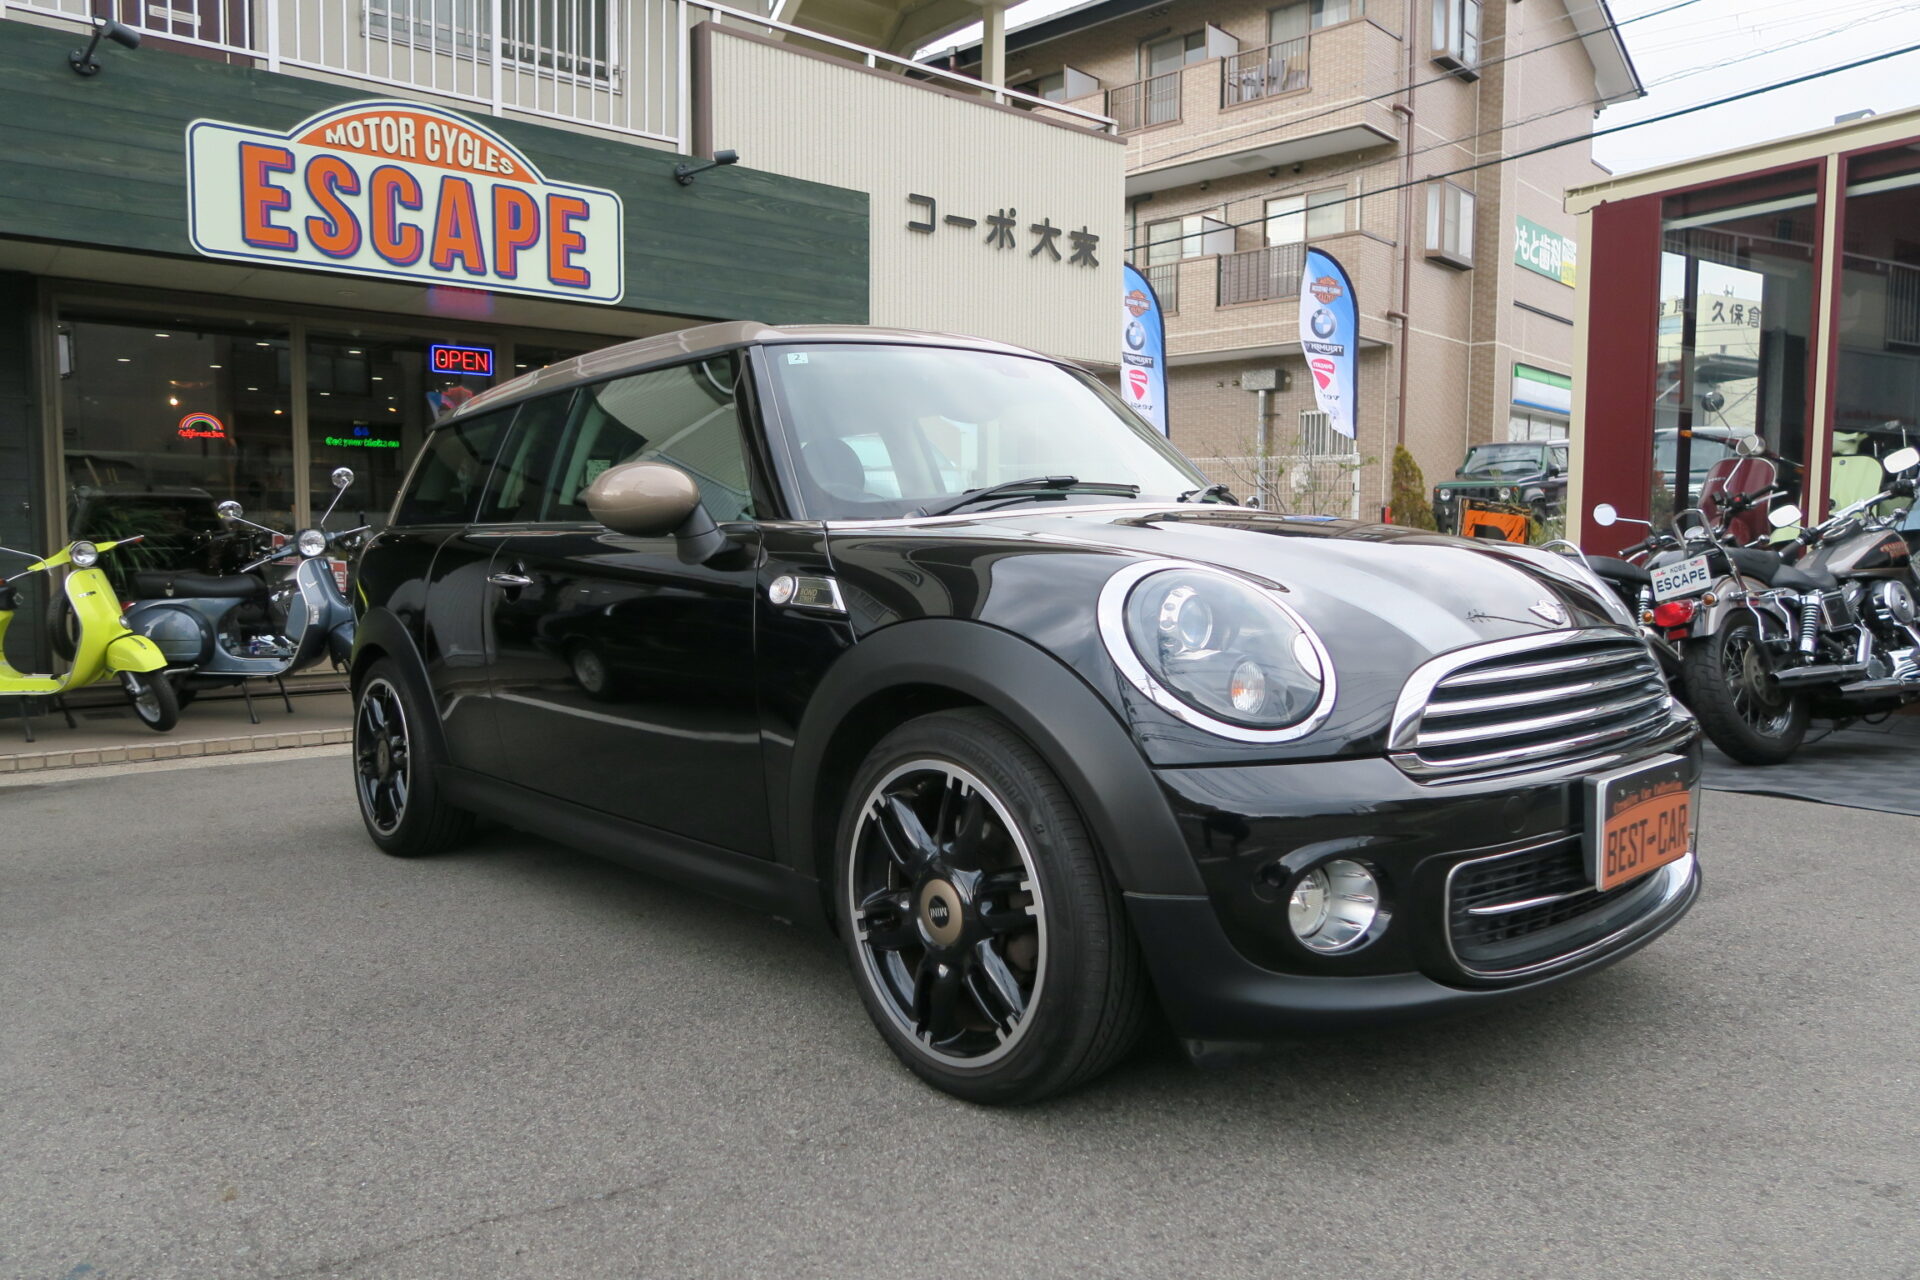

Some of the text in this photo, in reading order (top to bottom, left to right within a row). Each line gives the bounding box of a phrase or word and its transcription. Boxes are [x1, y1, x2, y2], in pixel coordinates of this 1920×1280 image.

[325, 116, 515, 176] MOTOR CYCLES
[239, 140, 591, 289] ESCAPE
[1515, 224, 1562, 275] もと歯科
[435, 349, 488, 371] OPEN
[1656, 568, 1707, 593] ESCAPE
[1670, 563, 1687, 574] KOBE
[1607, 804, 1688, 877] BEST-CAR
[930, 906, 948, 918] MINI
